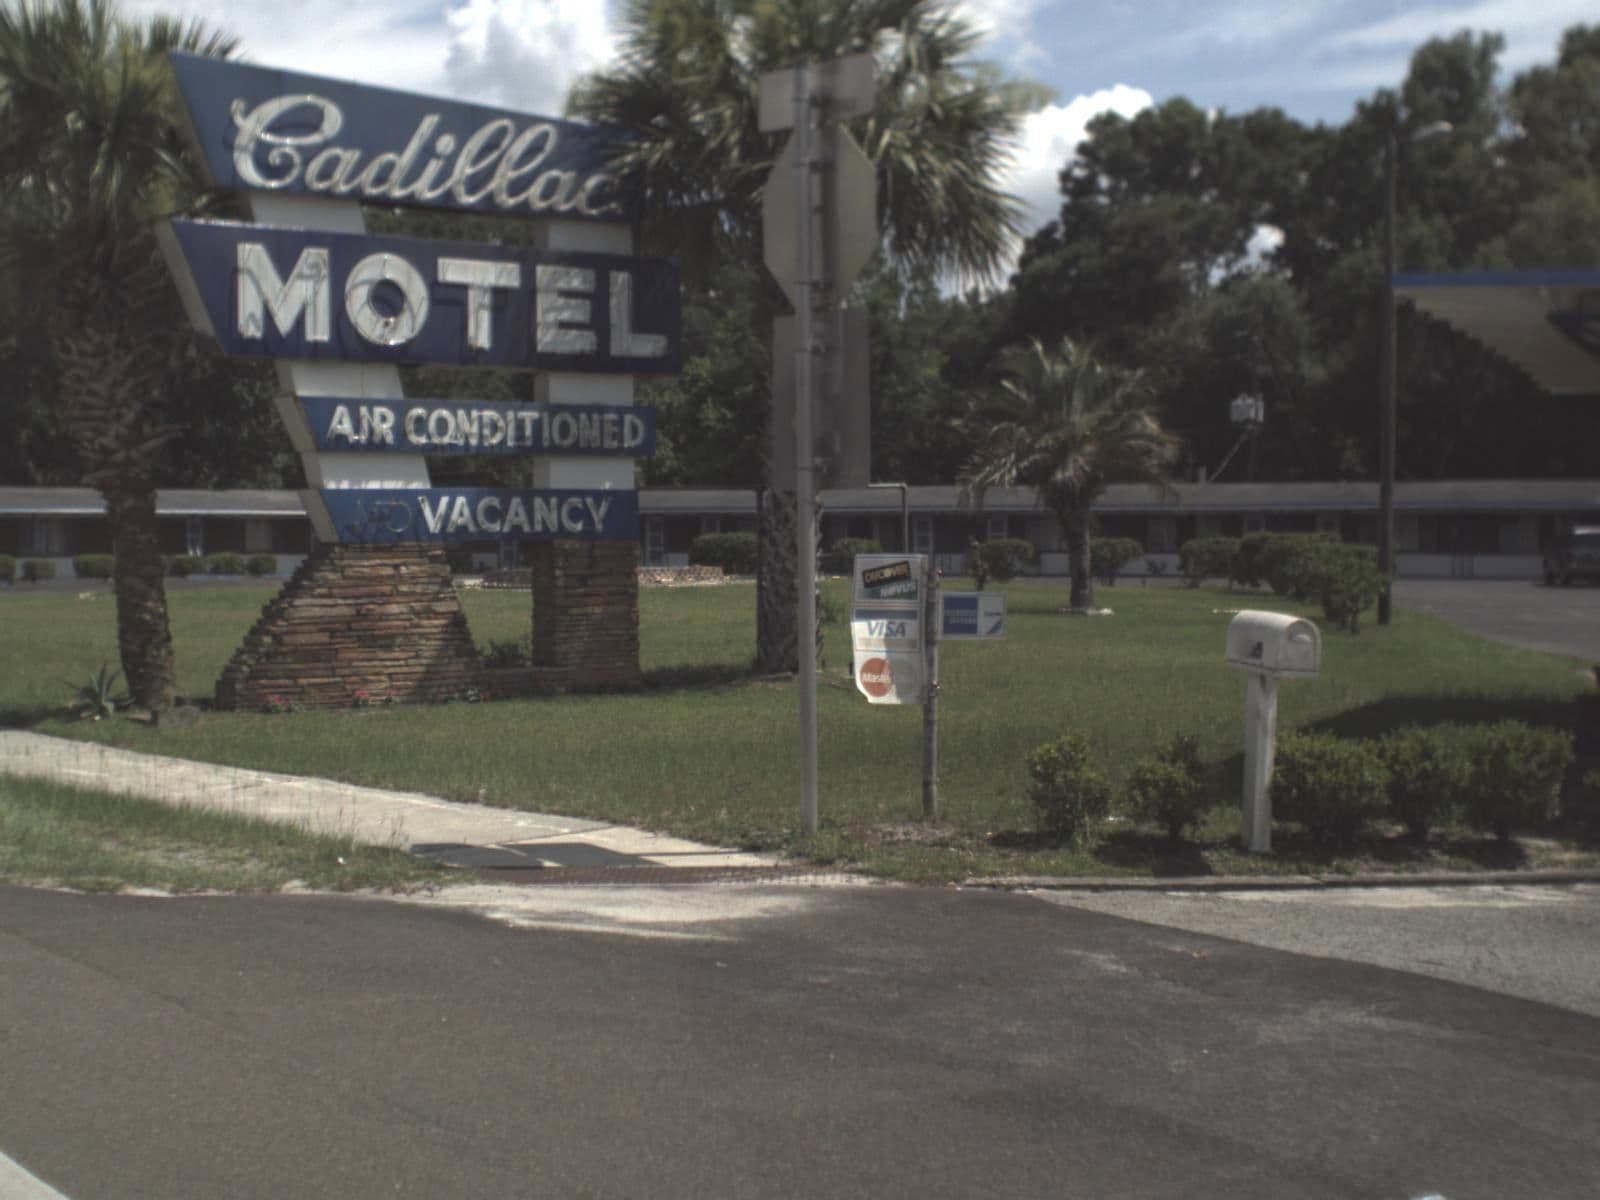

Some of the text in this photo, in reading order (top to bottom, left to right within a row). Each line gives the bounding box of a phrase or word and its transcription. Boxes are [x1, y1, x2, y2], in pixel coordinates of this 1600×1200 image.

[231, 94, 621, 216] Cadillac
[236, 241, 669, 358] MOTEL
[327, 404, 646, 449] AIR CONDITIONED
[417, 495, 610, 535] VACANCY
[867, 621, 907, 637] VISA
